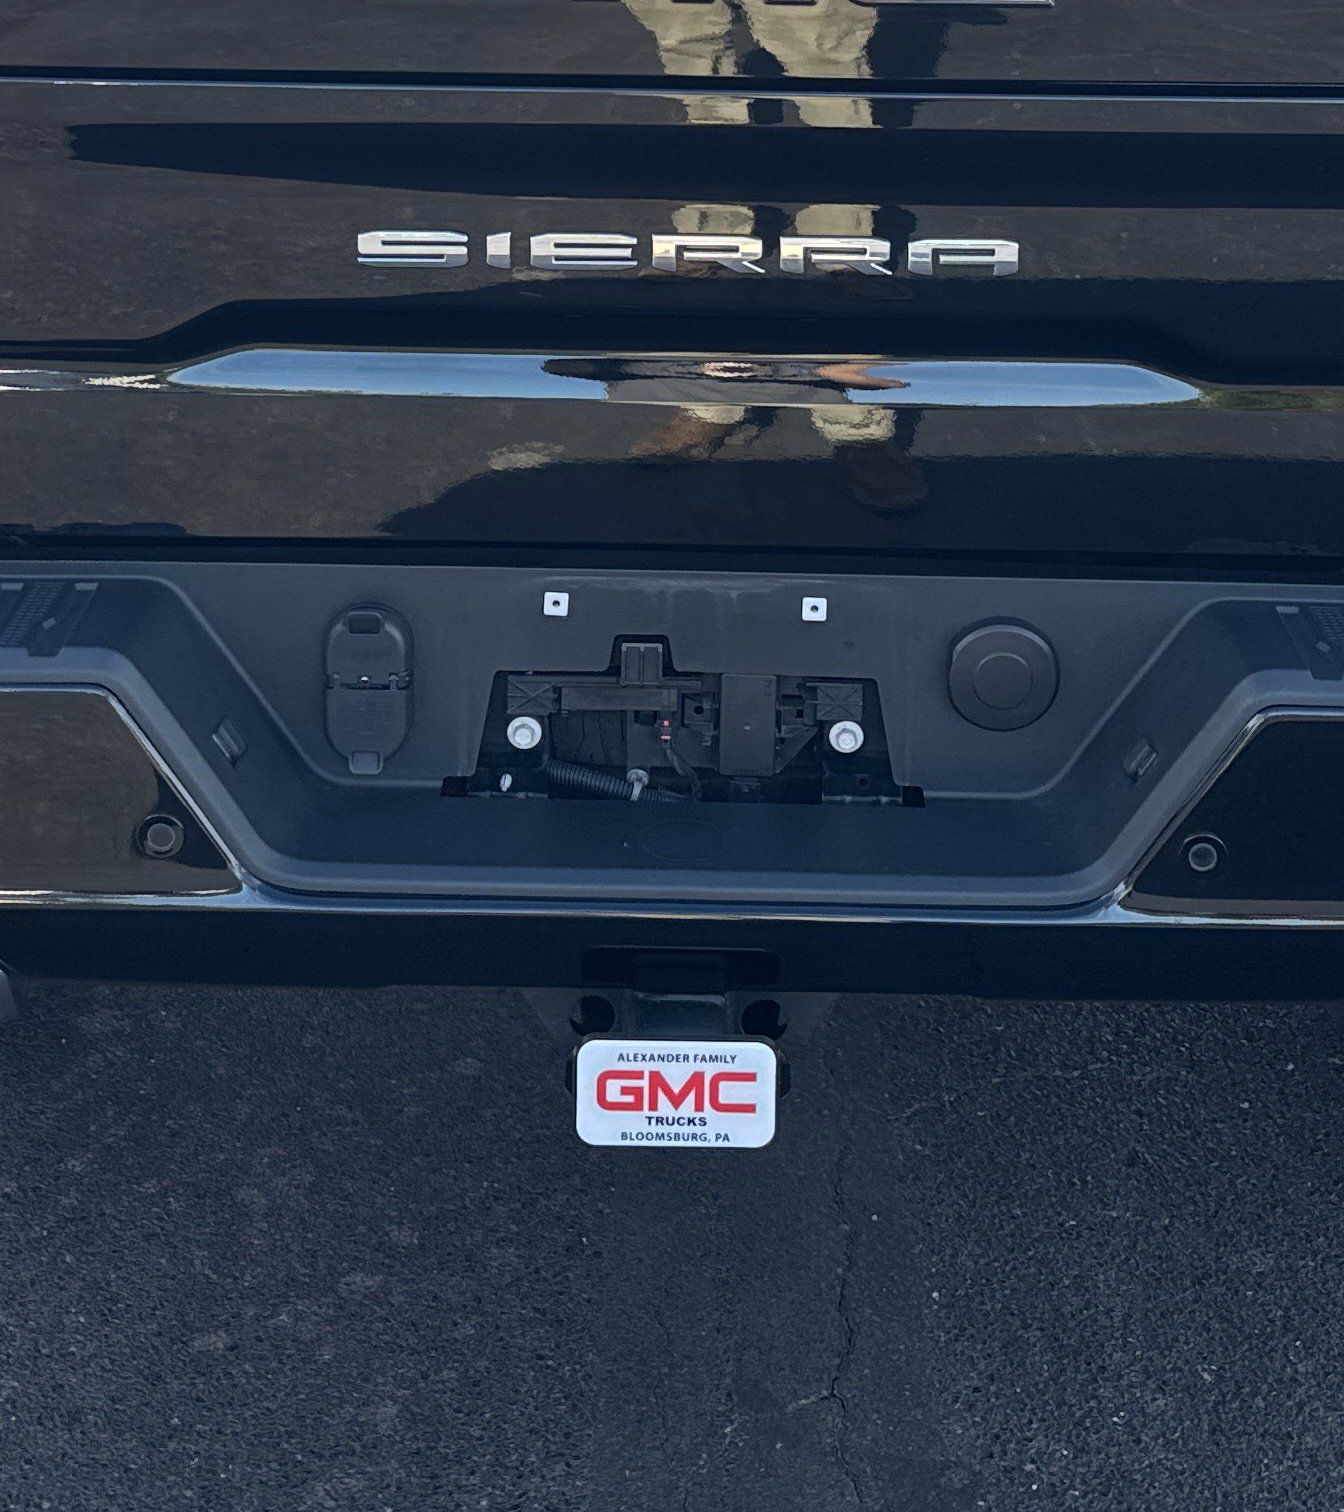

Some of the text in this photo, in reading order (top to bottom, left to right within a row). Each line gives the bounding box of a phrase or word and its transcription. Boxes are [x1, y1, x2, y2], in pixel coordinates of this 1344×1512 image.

[356, 231, 1021, 276] SIERRA
[617, 1052, 737, 1065] ALEXANDER FAMILY
[596, 1070, 757, 1114] GMC
[645, 1116, 707, 1127] TRUCKS
[620, 1131, 731, 1144] BLOOMSBURG, PA
